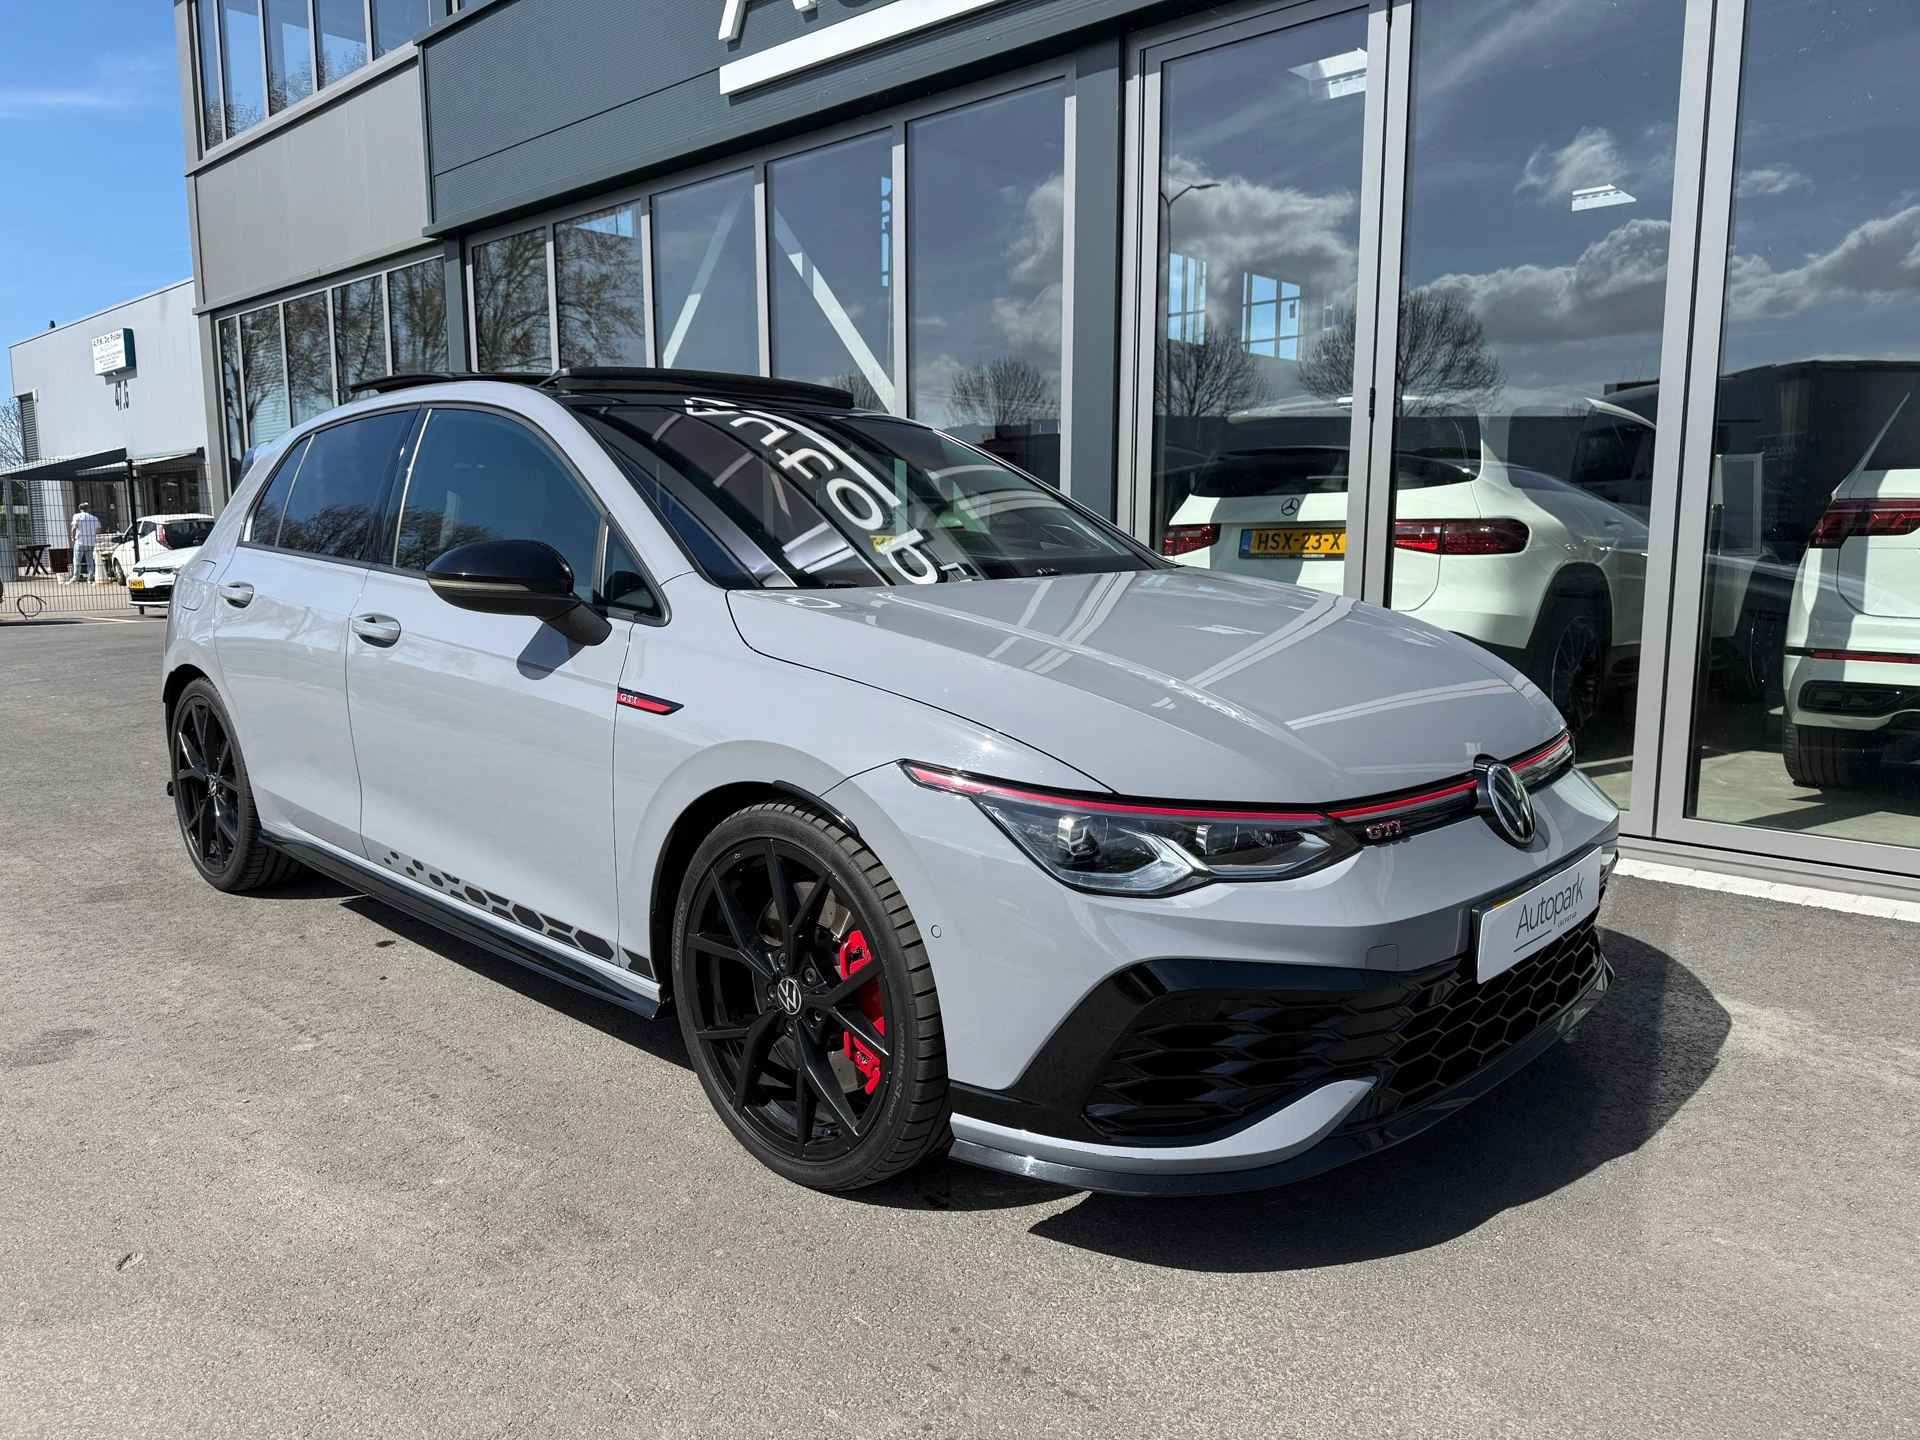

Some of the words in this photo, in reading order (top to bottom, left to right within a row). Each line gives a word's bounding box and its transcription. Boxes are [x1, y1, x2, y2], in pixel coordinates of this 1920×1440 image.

[1257, 531, 1342, 551] HSX-23-X
[620, 693, 638, 704] GTI
[1366, 820, 1402, 840] GTI
[1515, 872, 1584, 939] Autopark
